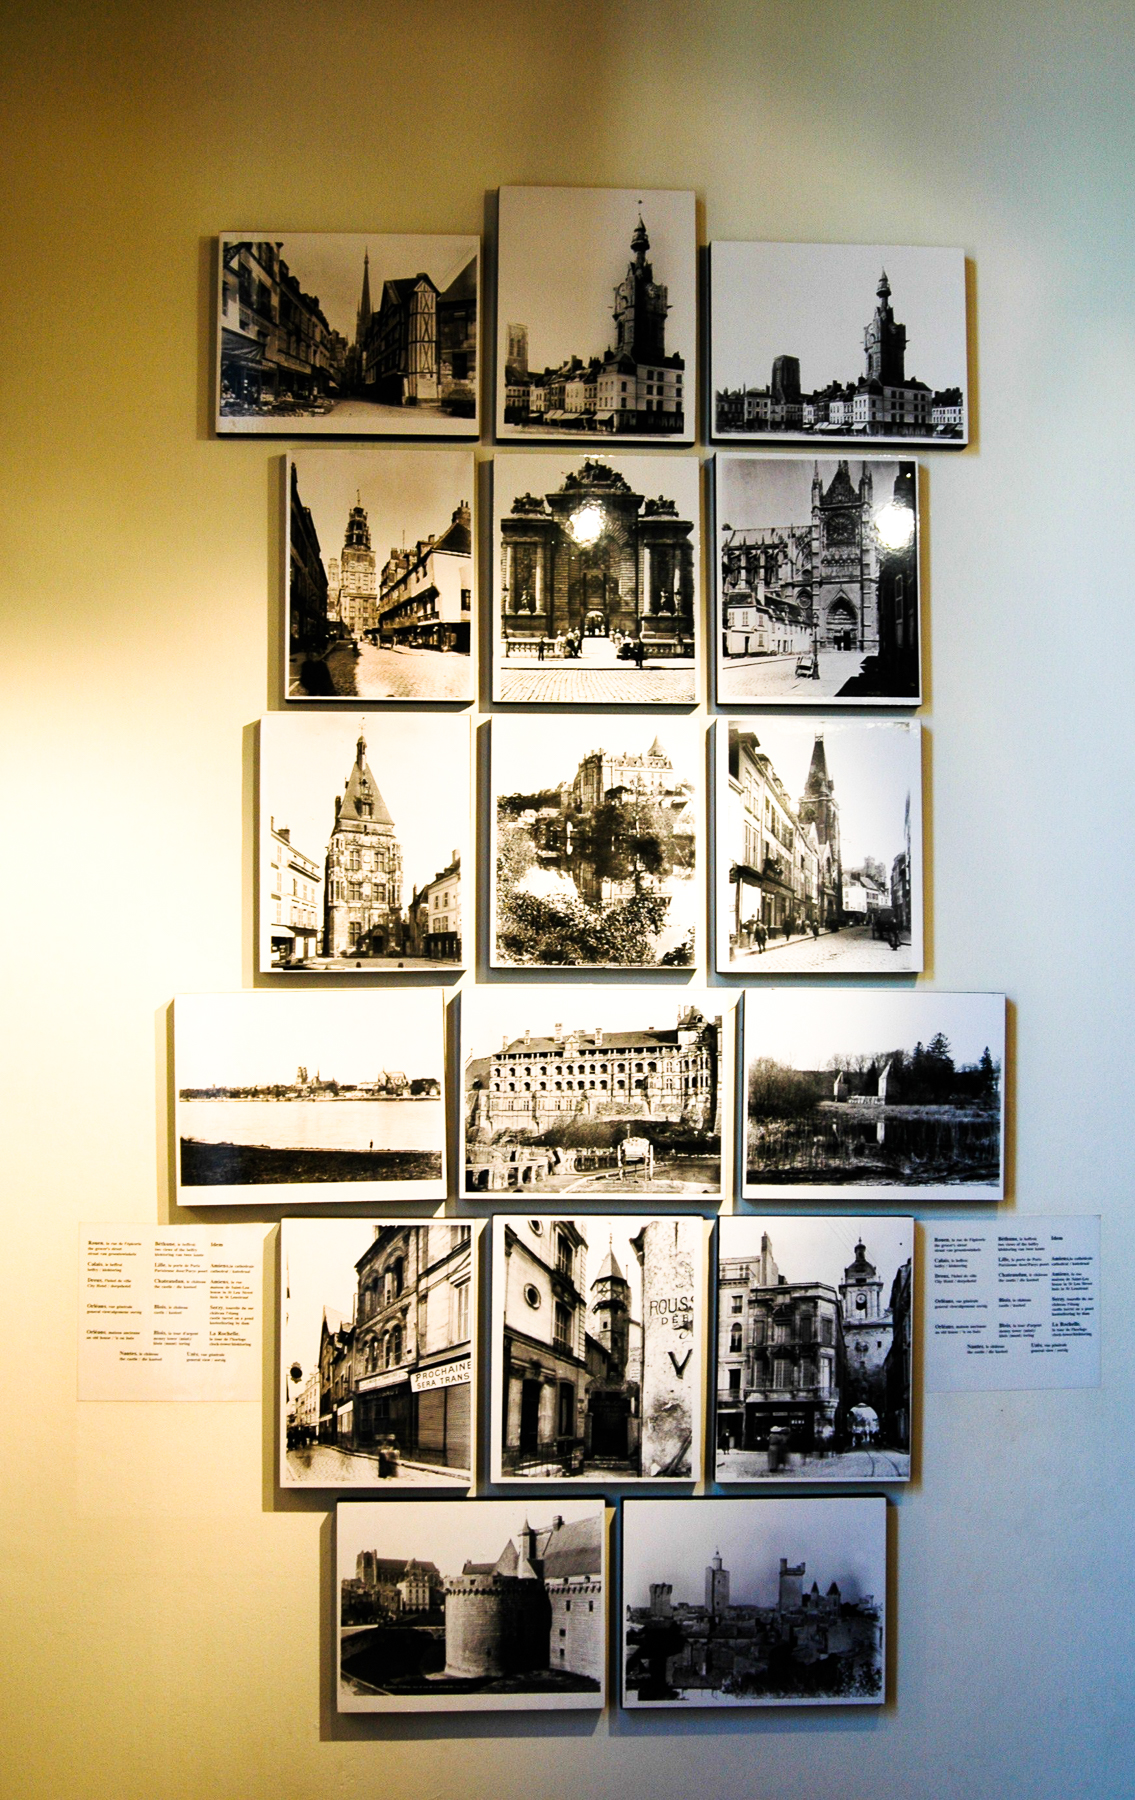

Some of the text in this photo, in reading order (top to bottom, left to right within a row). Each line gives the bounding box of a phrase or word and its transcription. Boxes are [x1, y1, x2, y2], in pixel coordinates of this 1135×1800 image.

[415, 1361, 471, 1382] PROCHAINE
[417, 1379, 436, 1390] SERA
[440, 1372, 470, 1384] TRANS
